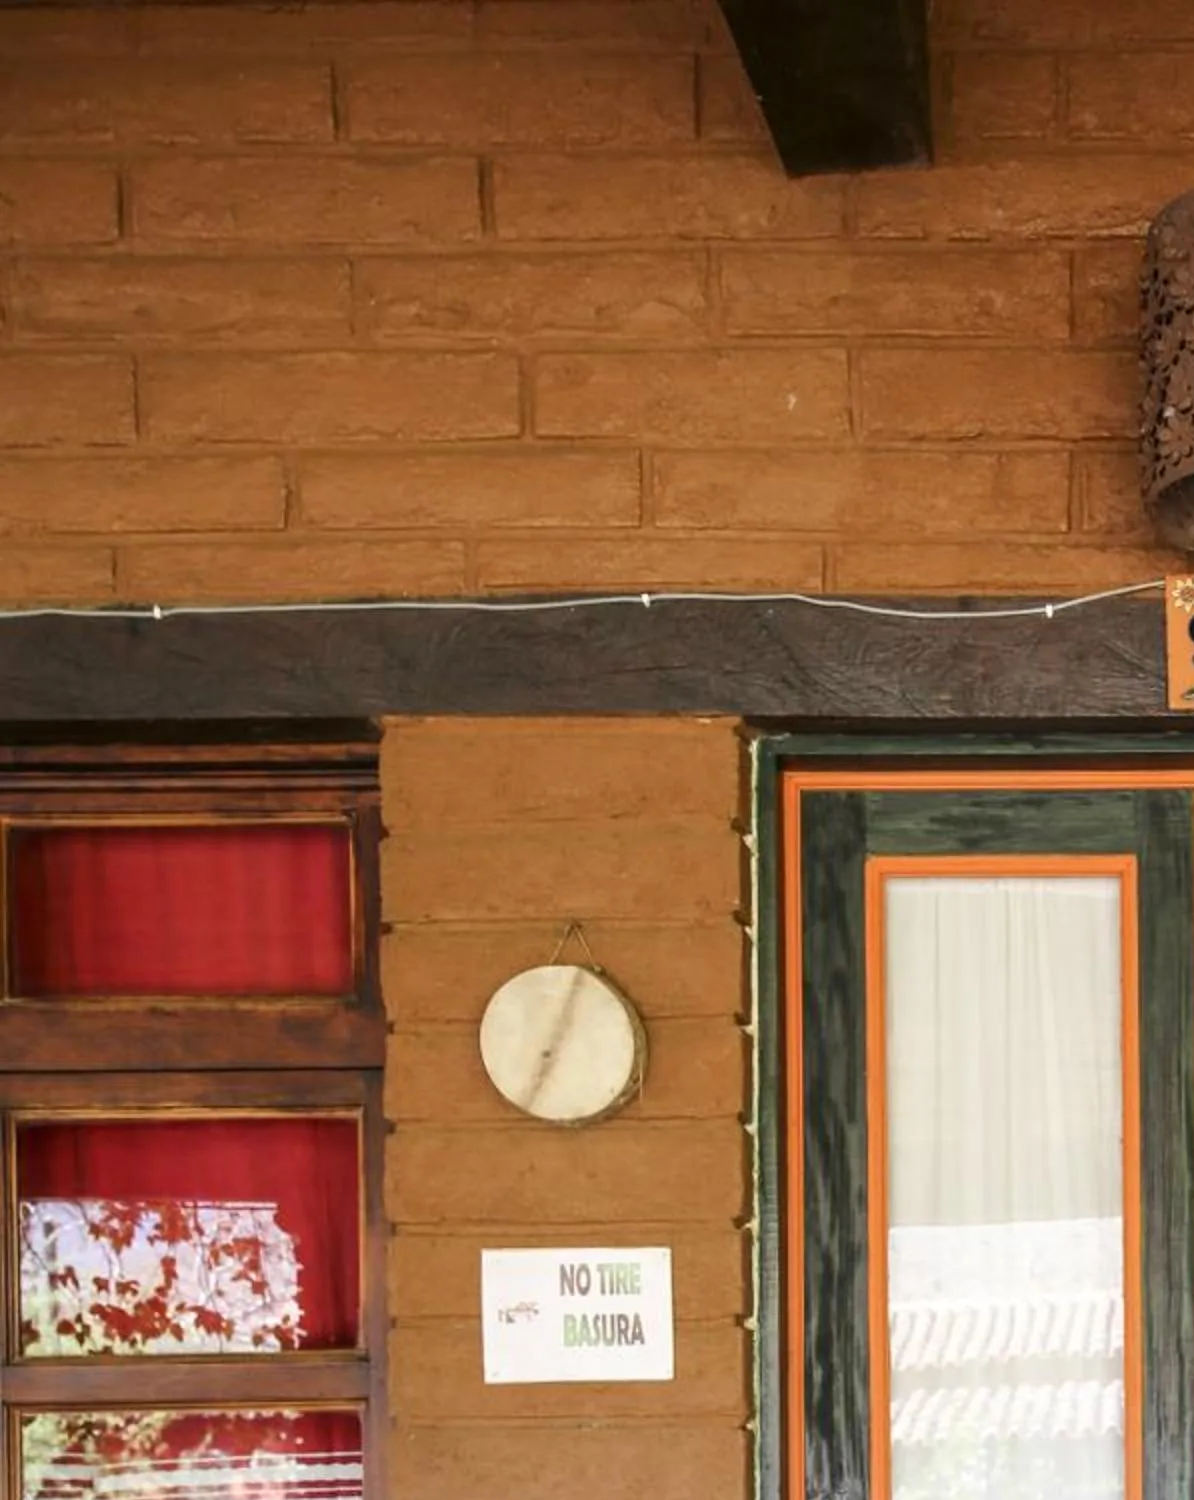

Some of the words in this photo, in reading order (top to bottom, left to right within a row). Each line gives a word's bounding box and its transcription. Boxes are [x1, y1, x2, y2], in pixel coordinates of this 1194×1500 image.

[560, 1263, 592, 1296] NO
[597, 1262, 642, 1296] TIRE
[563, 1312, 645, 1348] BASURA
